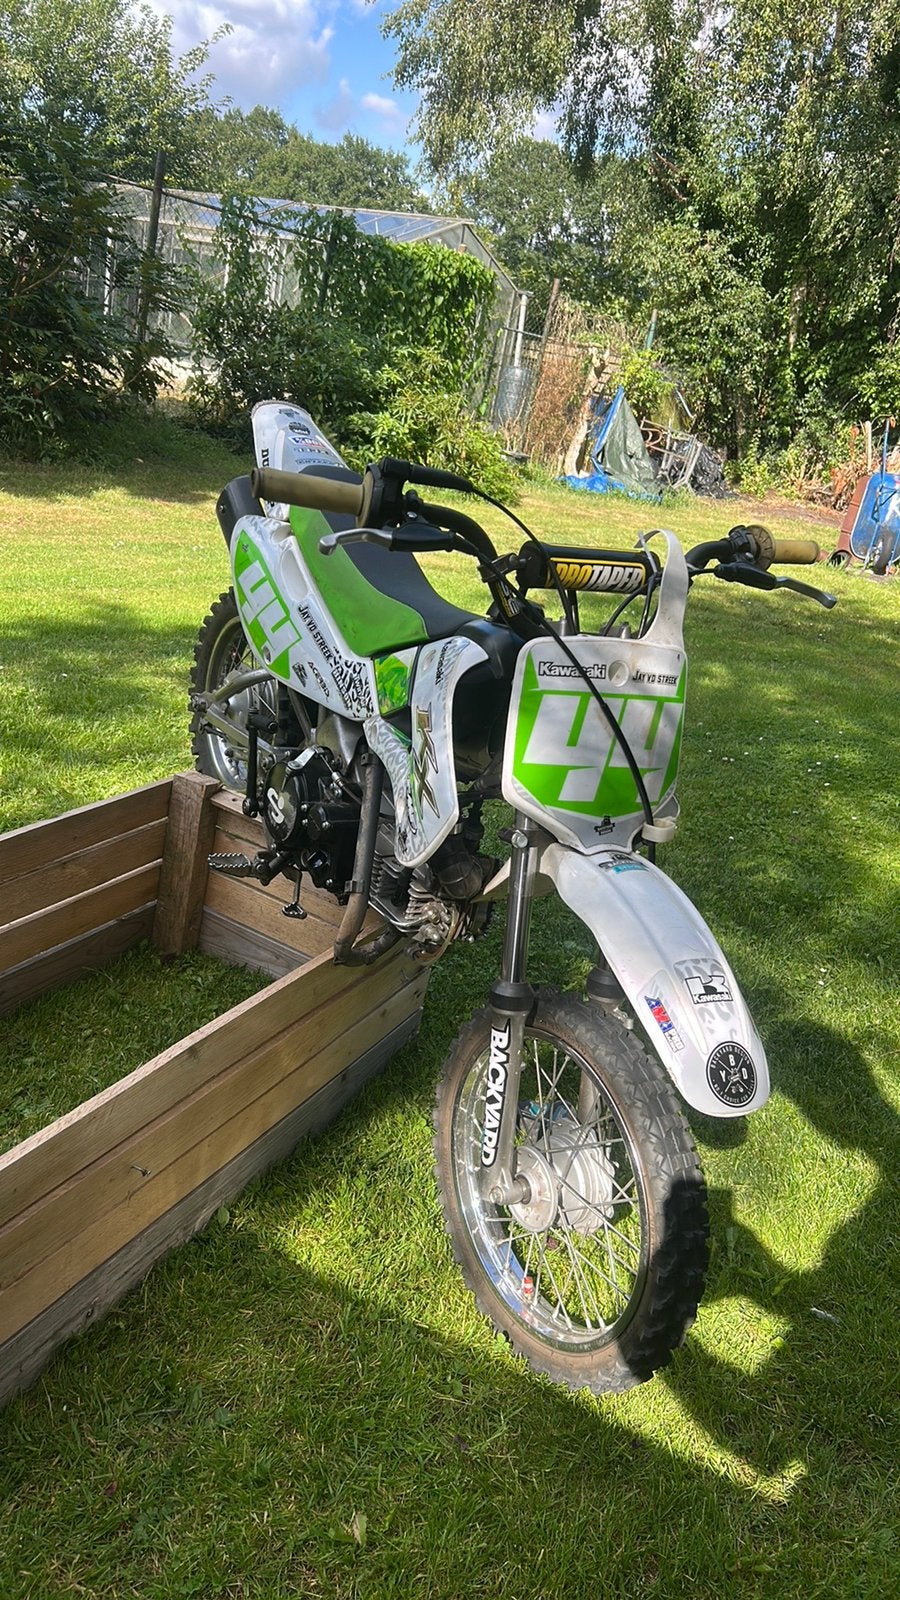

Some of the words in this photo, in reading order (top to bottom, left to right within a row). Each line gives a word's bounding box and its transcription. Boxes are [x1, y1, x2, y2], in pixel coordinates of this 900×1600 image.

[556, 563, 644, 593] PROTAPER
[313, 631, 334, 661] STREEK
[522, 694, 684, 803] 44
[481, 1018, 511, 1168] BACKYARD
